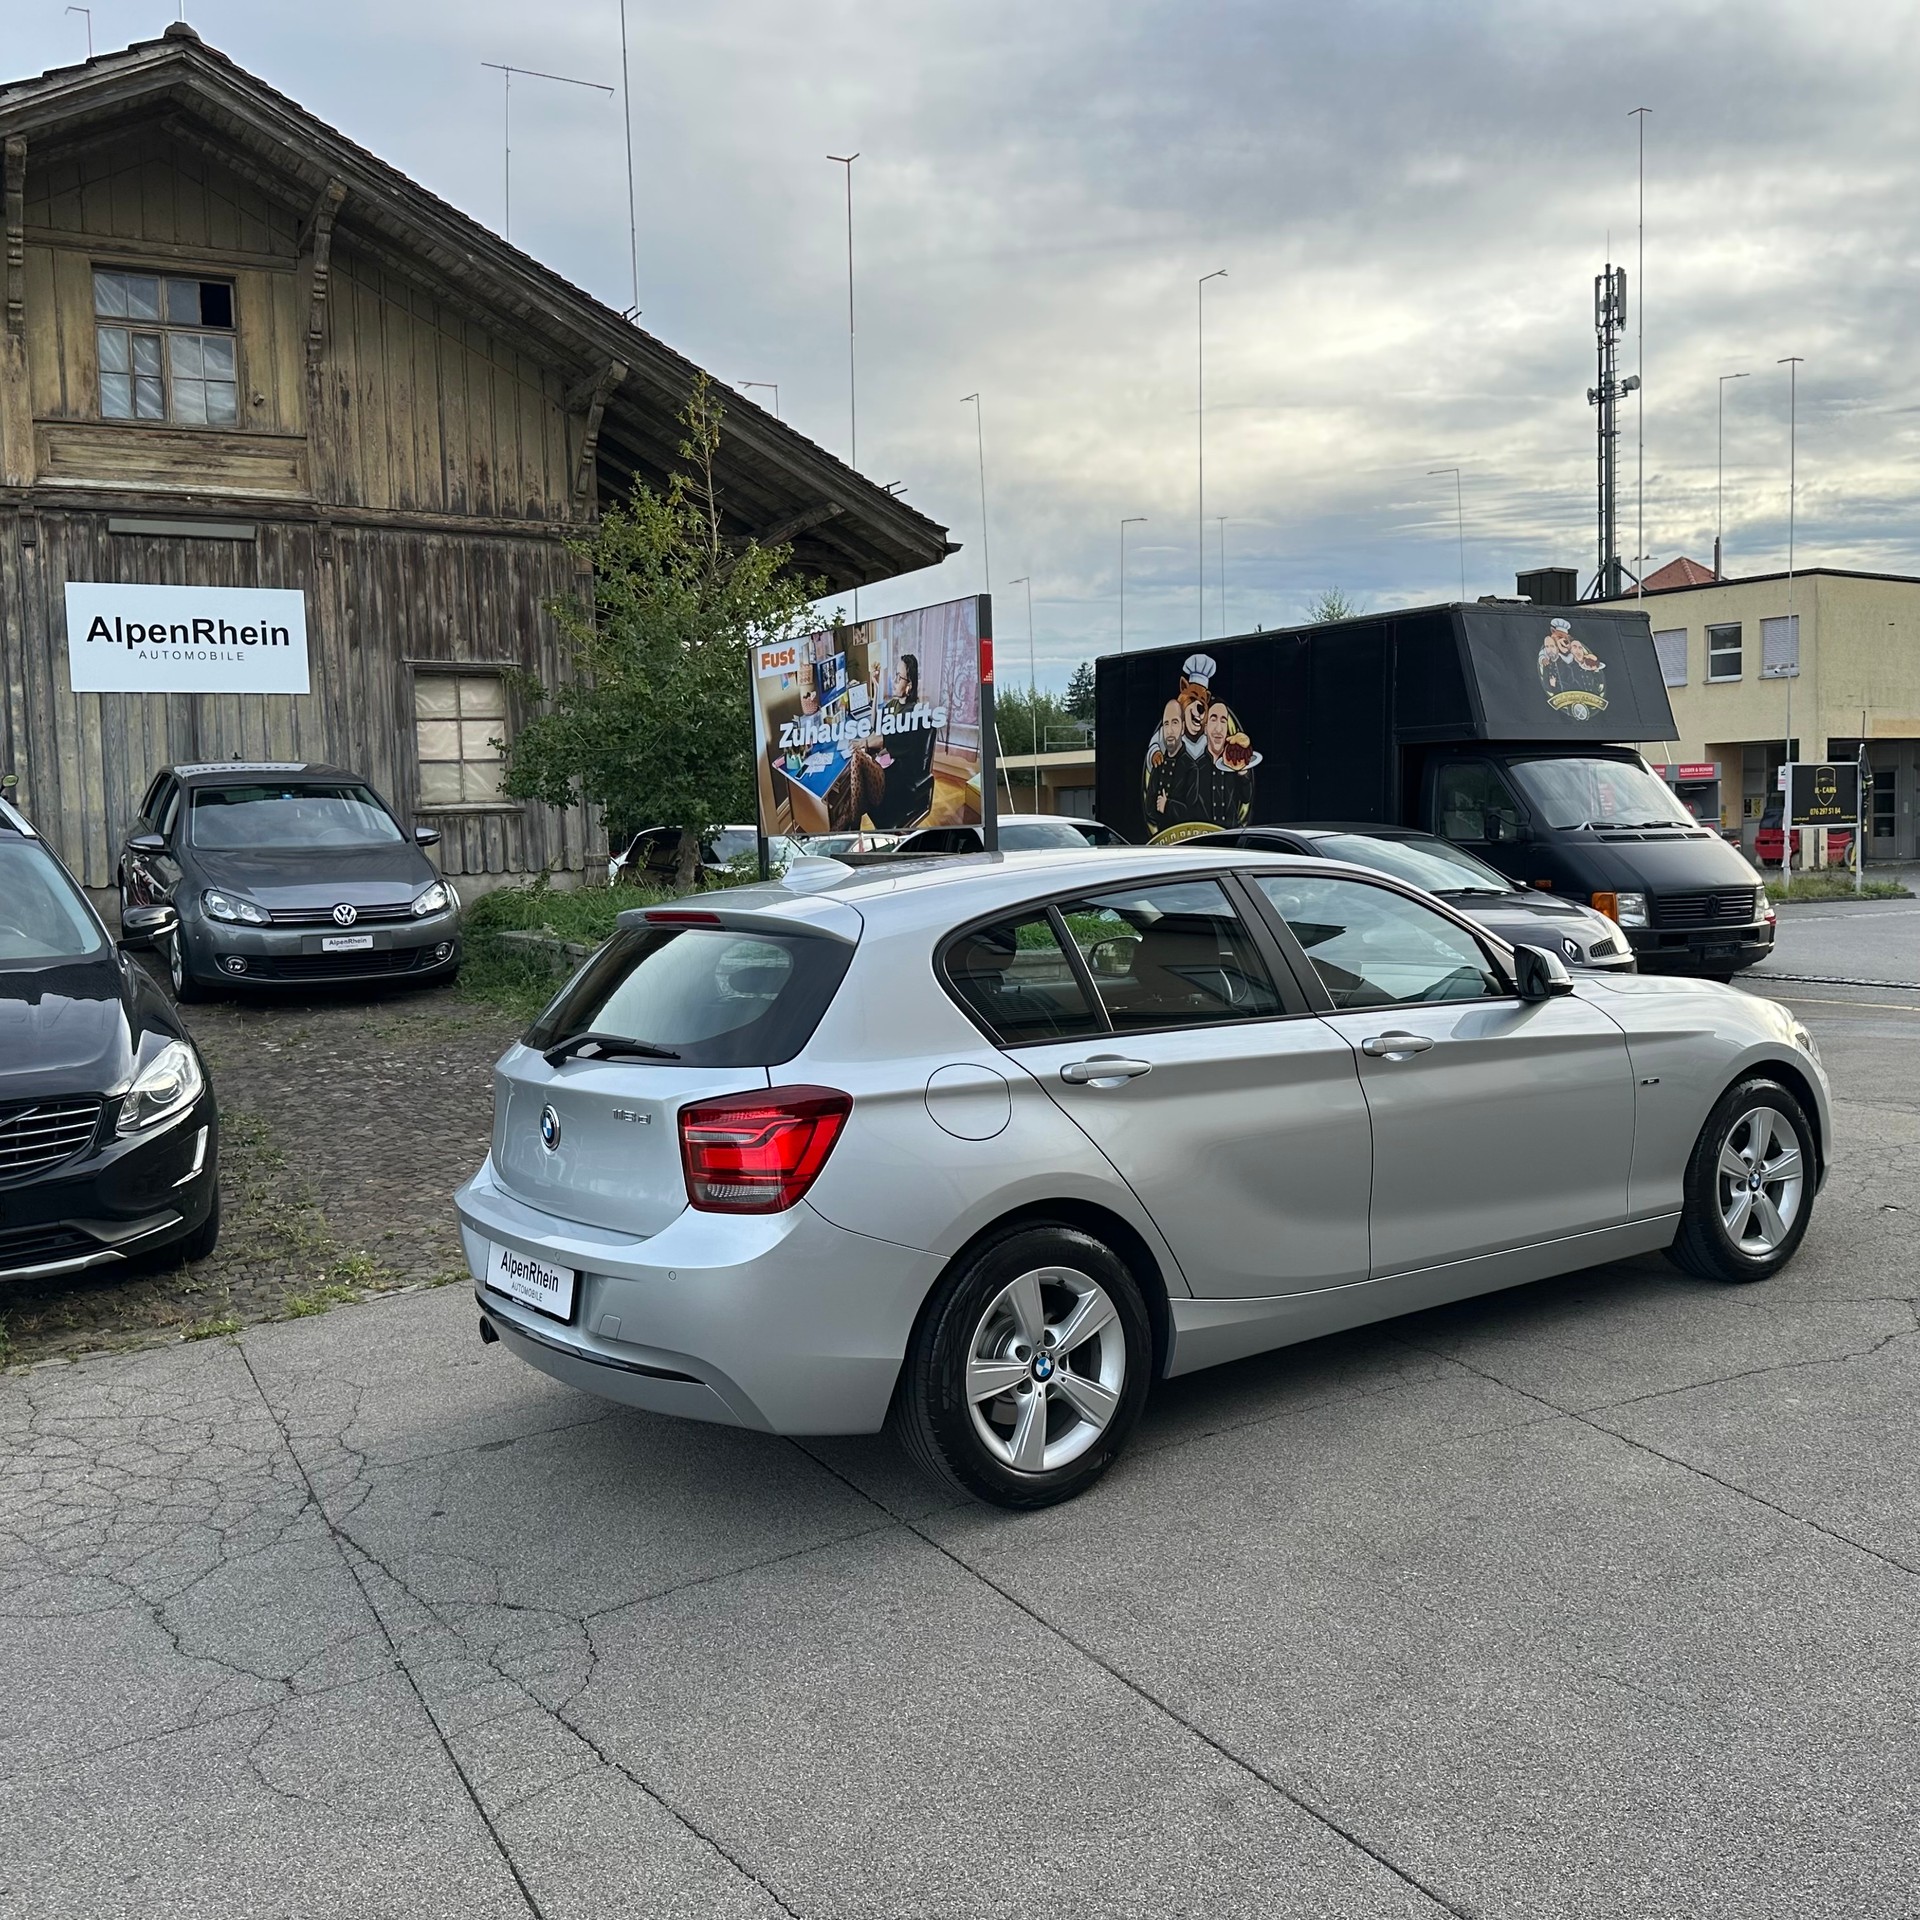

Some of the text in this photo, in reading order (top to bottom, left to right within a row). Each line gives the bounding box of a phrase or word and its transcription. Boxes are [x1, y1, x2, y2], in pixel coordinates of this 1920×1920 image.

[86, 616, 290, 650] AlpenRhein
[138, 650, 245, 661] AUTOMOBILE
[761, 646, 796, 670] Fust
[778, 702, 948, 749] Zuhause läufts
[500, 1250, 560, 1293] AlpenRhein
[511, 1281, 543, 1302] AUTOMOBILE
